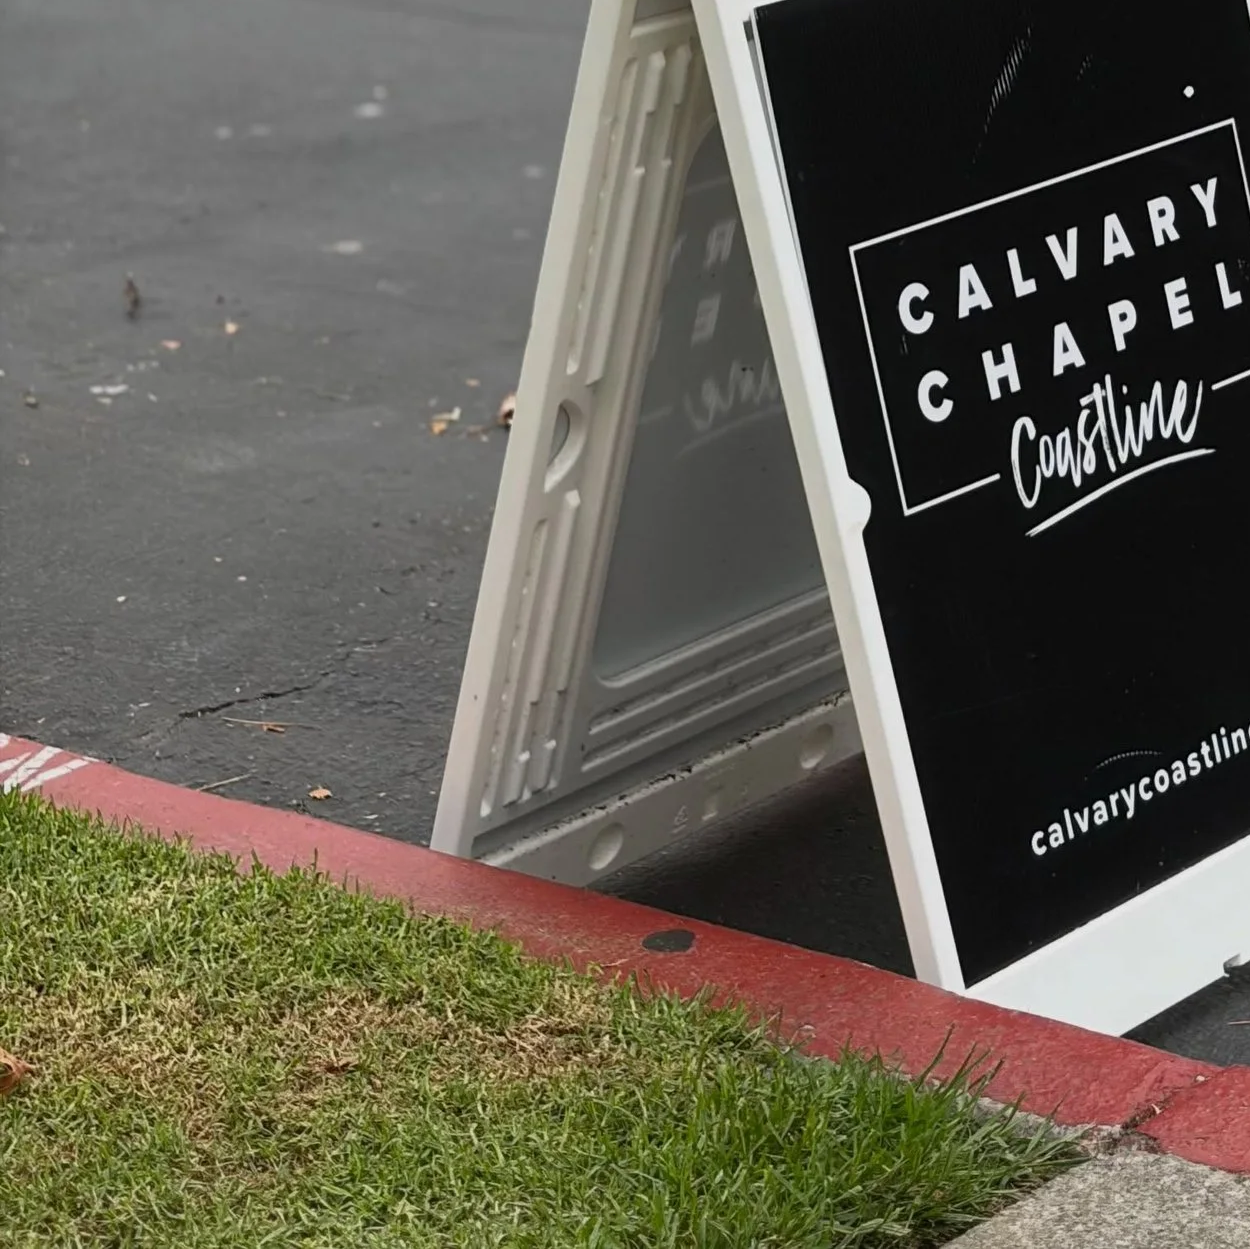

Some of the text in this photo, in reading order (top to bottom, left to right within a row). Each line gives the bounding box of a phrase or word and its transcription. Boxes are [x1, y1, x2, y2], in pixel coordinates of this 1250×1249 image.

[898, 177, 1218, 335] CALVARY
[917, 263, 1242, 423] CHAPEL
[1010, 374, 1203, 508] Coastline
